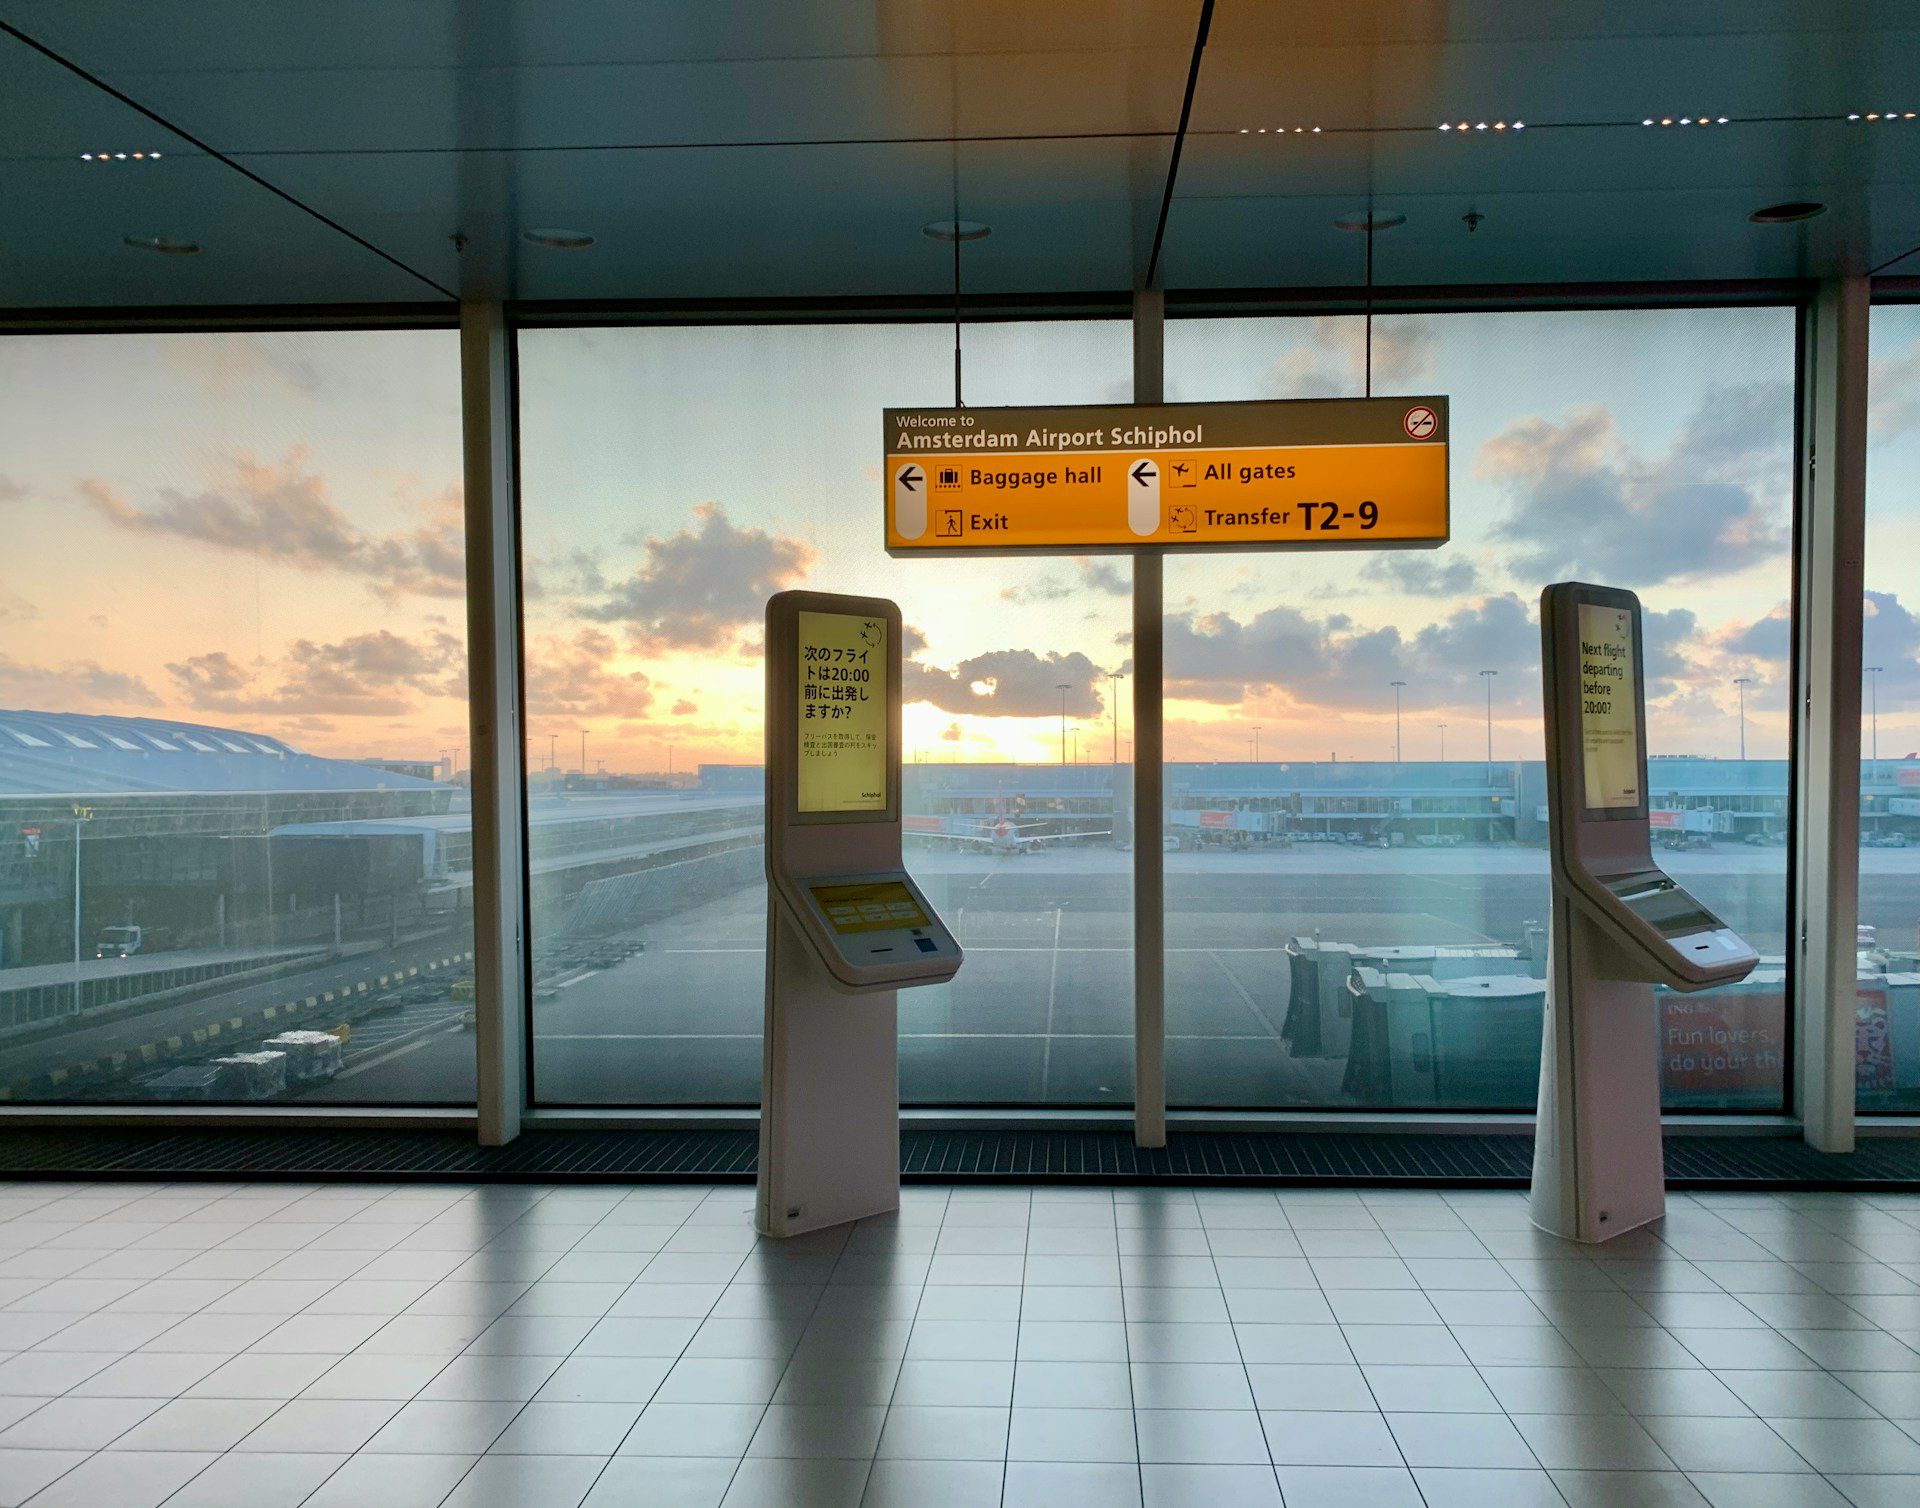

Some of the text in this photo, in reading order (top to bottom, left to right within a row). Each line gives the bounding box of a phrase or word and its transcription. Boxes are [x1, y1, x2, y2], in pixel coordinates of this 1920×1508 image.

[896, 415, 975, 427] Welcome to
[897, 425, 1202, 450] Amsterdam Airport Schiphol
[970, 466, 1102, 489] Baggage hall
[1204, 463, 1296, 484] All gates
[971, 513, 1008, 530] Exit
[1204, 500, 1379, 531] Transfer T2-9
[804, 645, 869, 664] 次のフライ
[1582, 641, 1626, 661] Next flight
[807, 665, 870, 683] トは20:00
[1583, 661, 1623, 680] departing
[804, 684, 869, 701] 前に出発し
[1583, 680, 1611, 695] before
[1584, 701, 1611, 714] 20:00?
[1668, 1028, 1703, 1045] Fun
[1670, 1054, 1695, 1072] do
[1700, 1055, 1748, 1076] your
